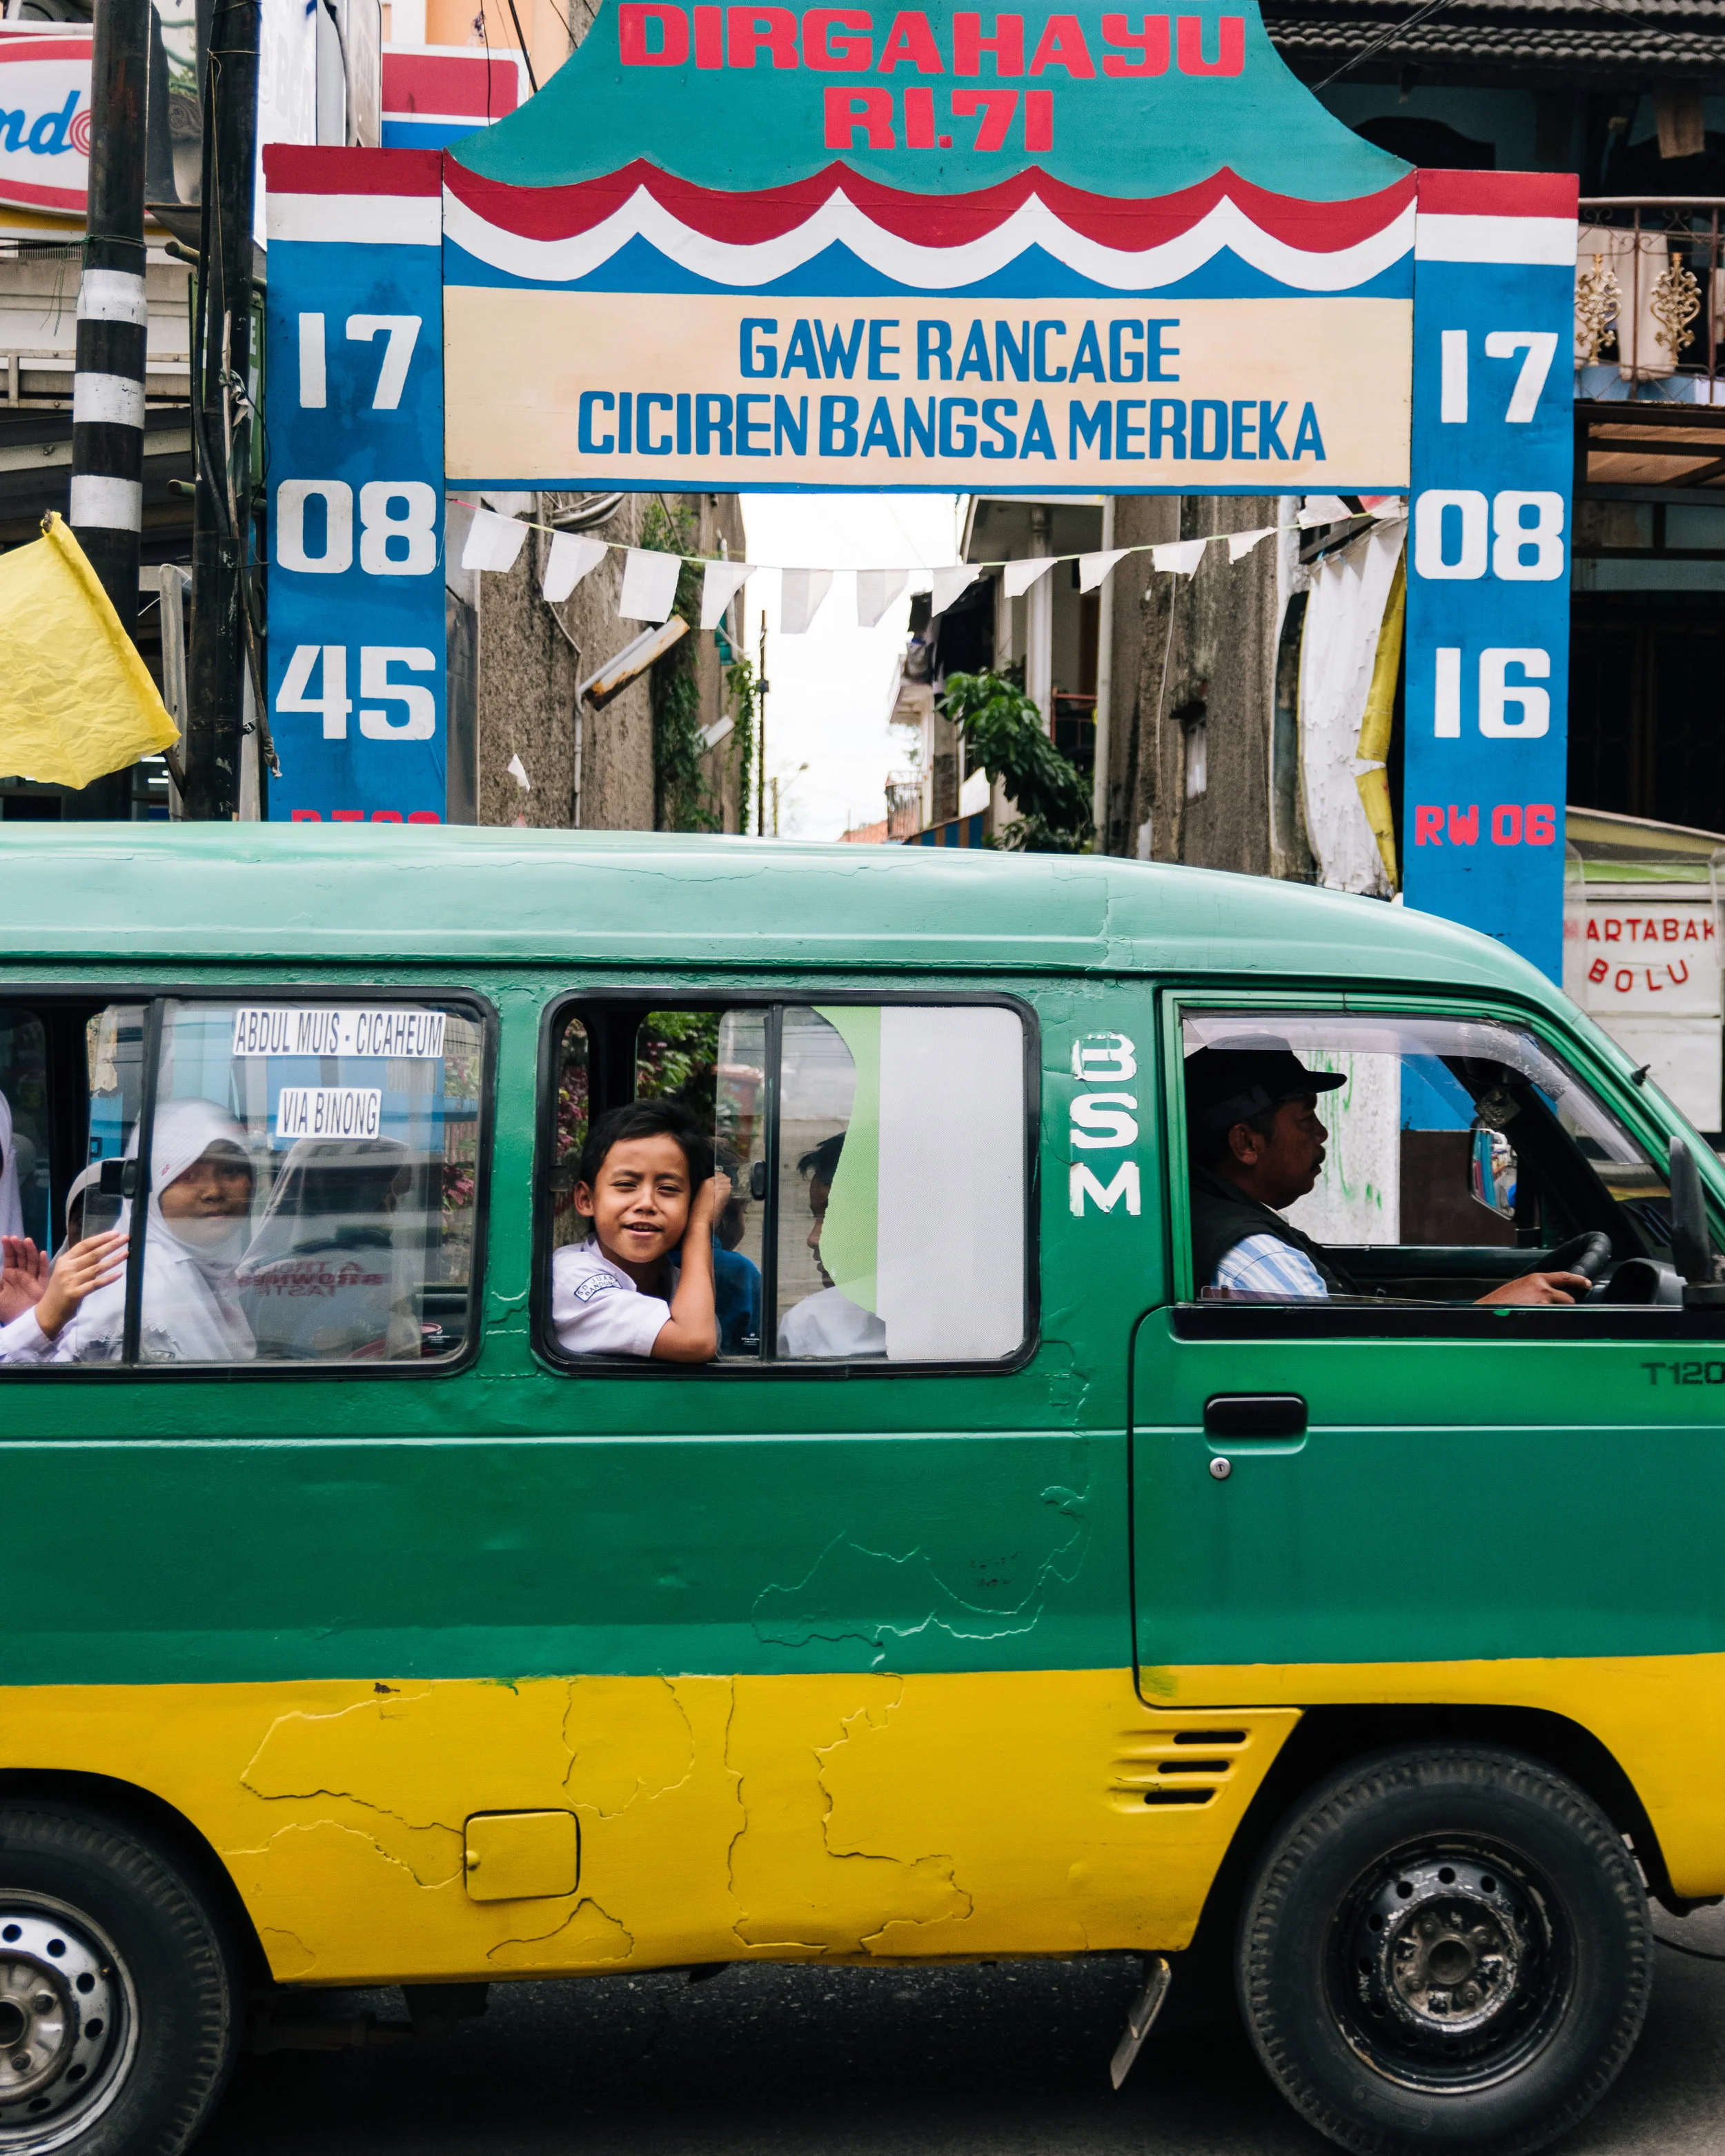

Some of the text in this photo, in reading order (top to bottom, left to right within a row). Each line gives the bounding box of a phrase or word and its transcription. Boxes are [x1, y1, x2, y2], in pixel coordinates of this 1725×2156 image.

[618, 2, 1246, 79] DIRGAHAYU
[299, 312, 422, 410] 17
[740, 318, 1180, 383] GAWE RANCAGE
[1441, 329, 1559, 424] 17
[578, 392, 1325, 461] CICIREN BANGSA MERDEKA
[277, 479, 436, 575] 08
[1414, 489, 1564, 582] 08
[275, 644, 436, 740] 45
[1434, 647, 1551, 739] 16
[1414, 804, 1556, 847] RW 06
[1588, 958, 1689, 993] BOLU
[235, 1011, 290, 1053] ABDUL
[297, 1011, 340, 1054] MUIS
[355, 1013, 443, 1056] CICAHEUM
[284, 1091, 377, 1136] VIA BINONG
[1640, 1361, 1725, 1385] T120
